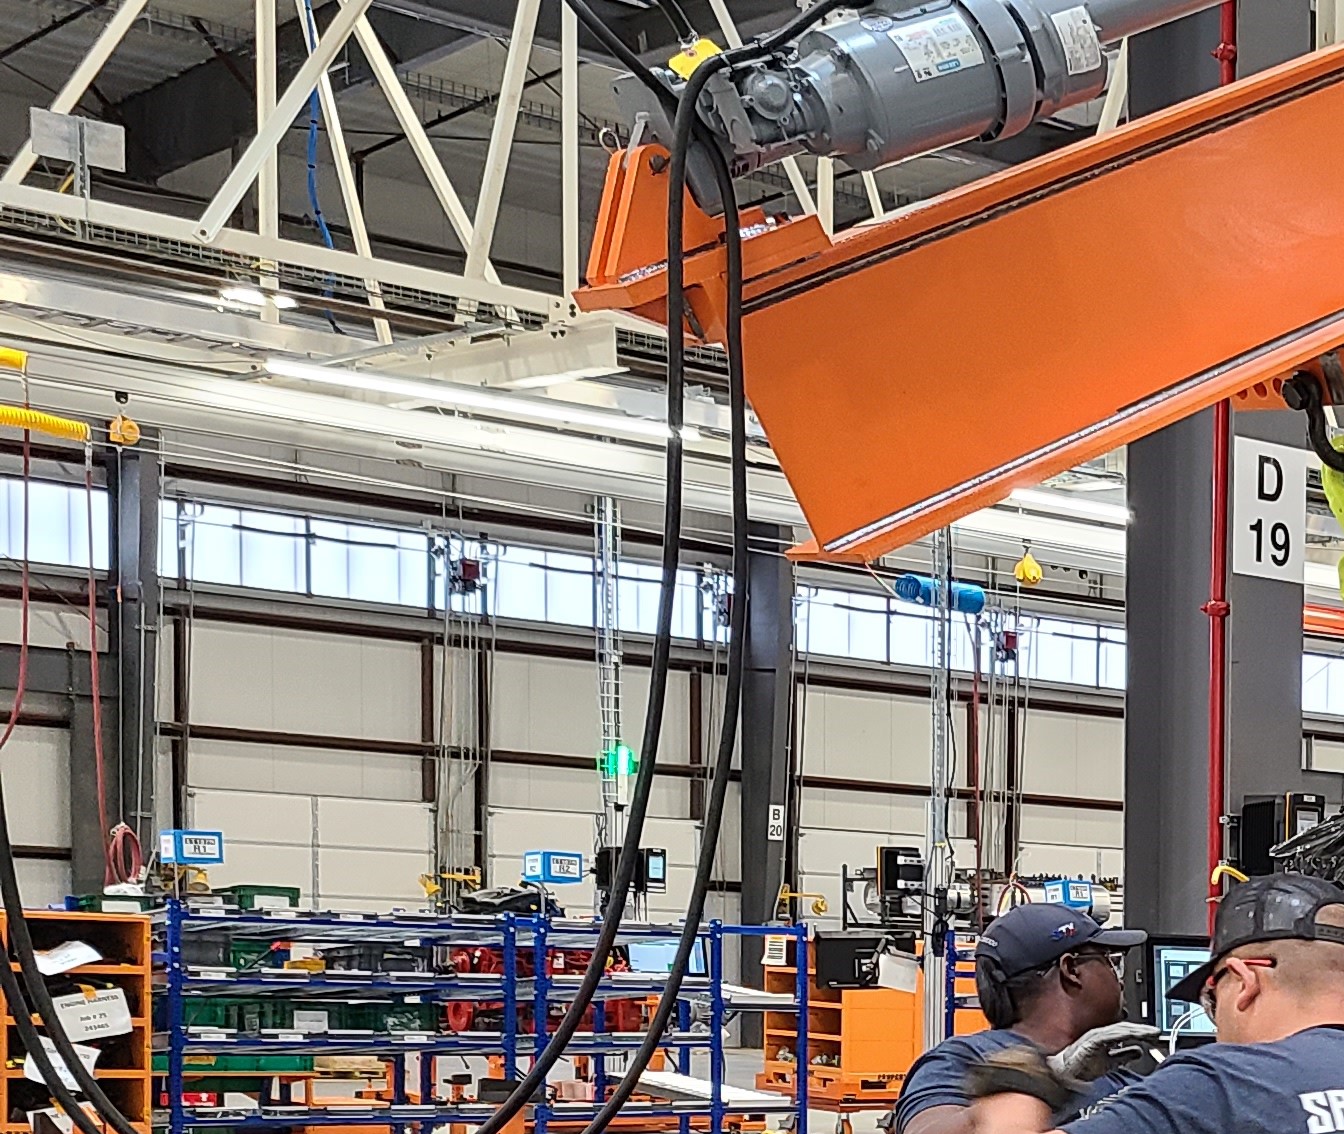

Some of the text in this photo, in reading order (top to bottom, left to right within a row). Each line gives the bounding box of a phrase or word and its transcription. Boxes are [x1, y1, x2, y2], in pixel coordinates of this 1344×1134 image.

[1257, 453, 1284, 503] D
[1248, 517, 1291, 567] 19
[772, 807, 781, 821] B
[769, 824, 783, 837] 20
